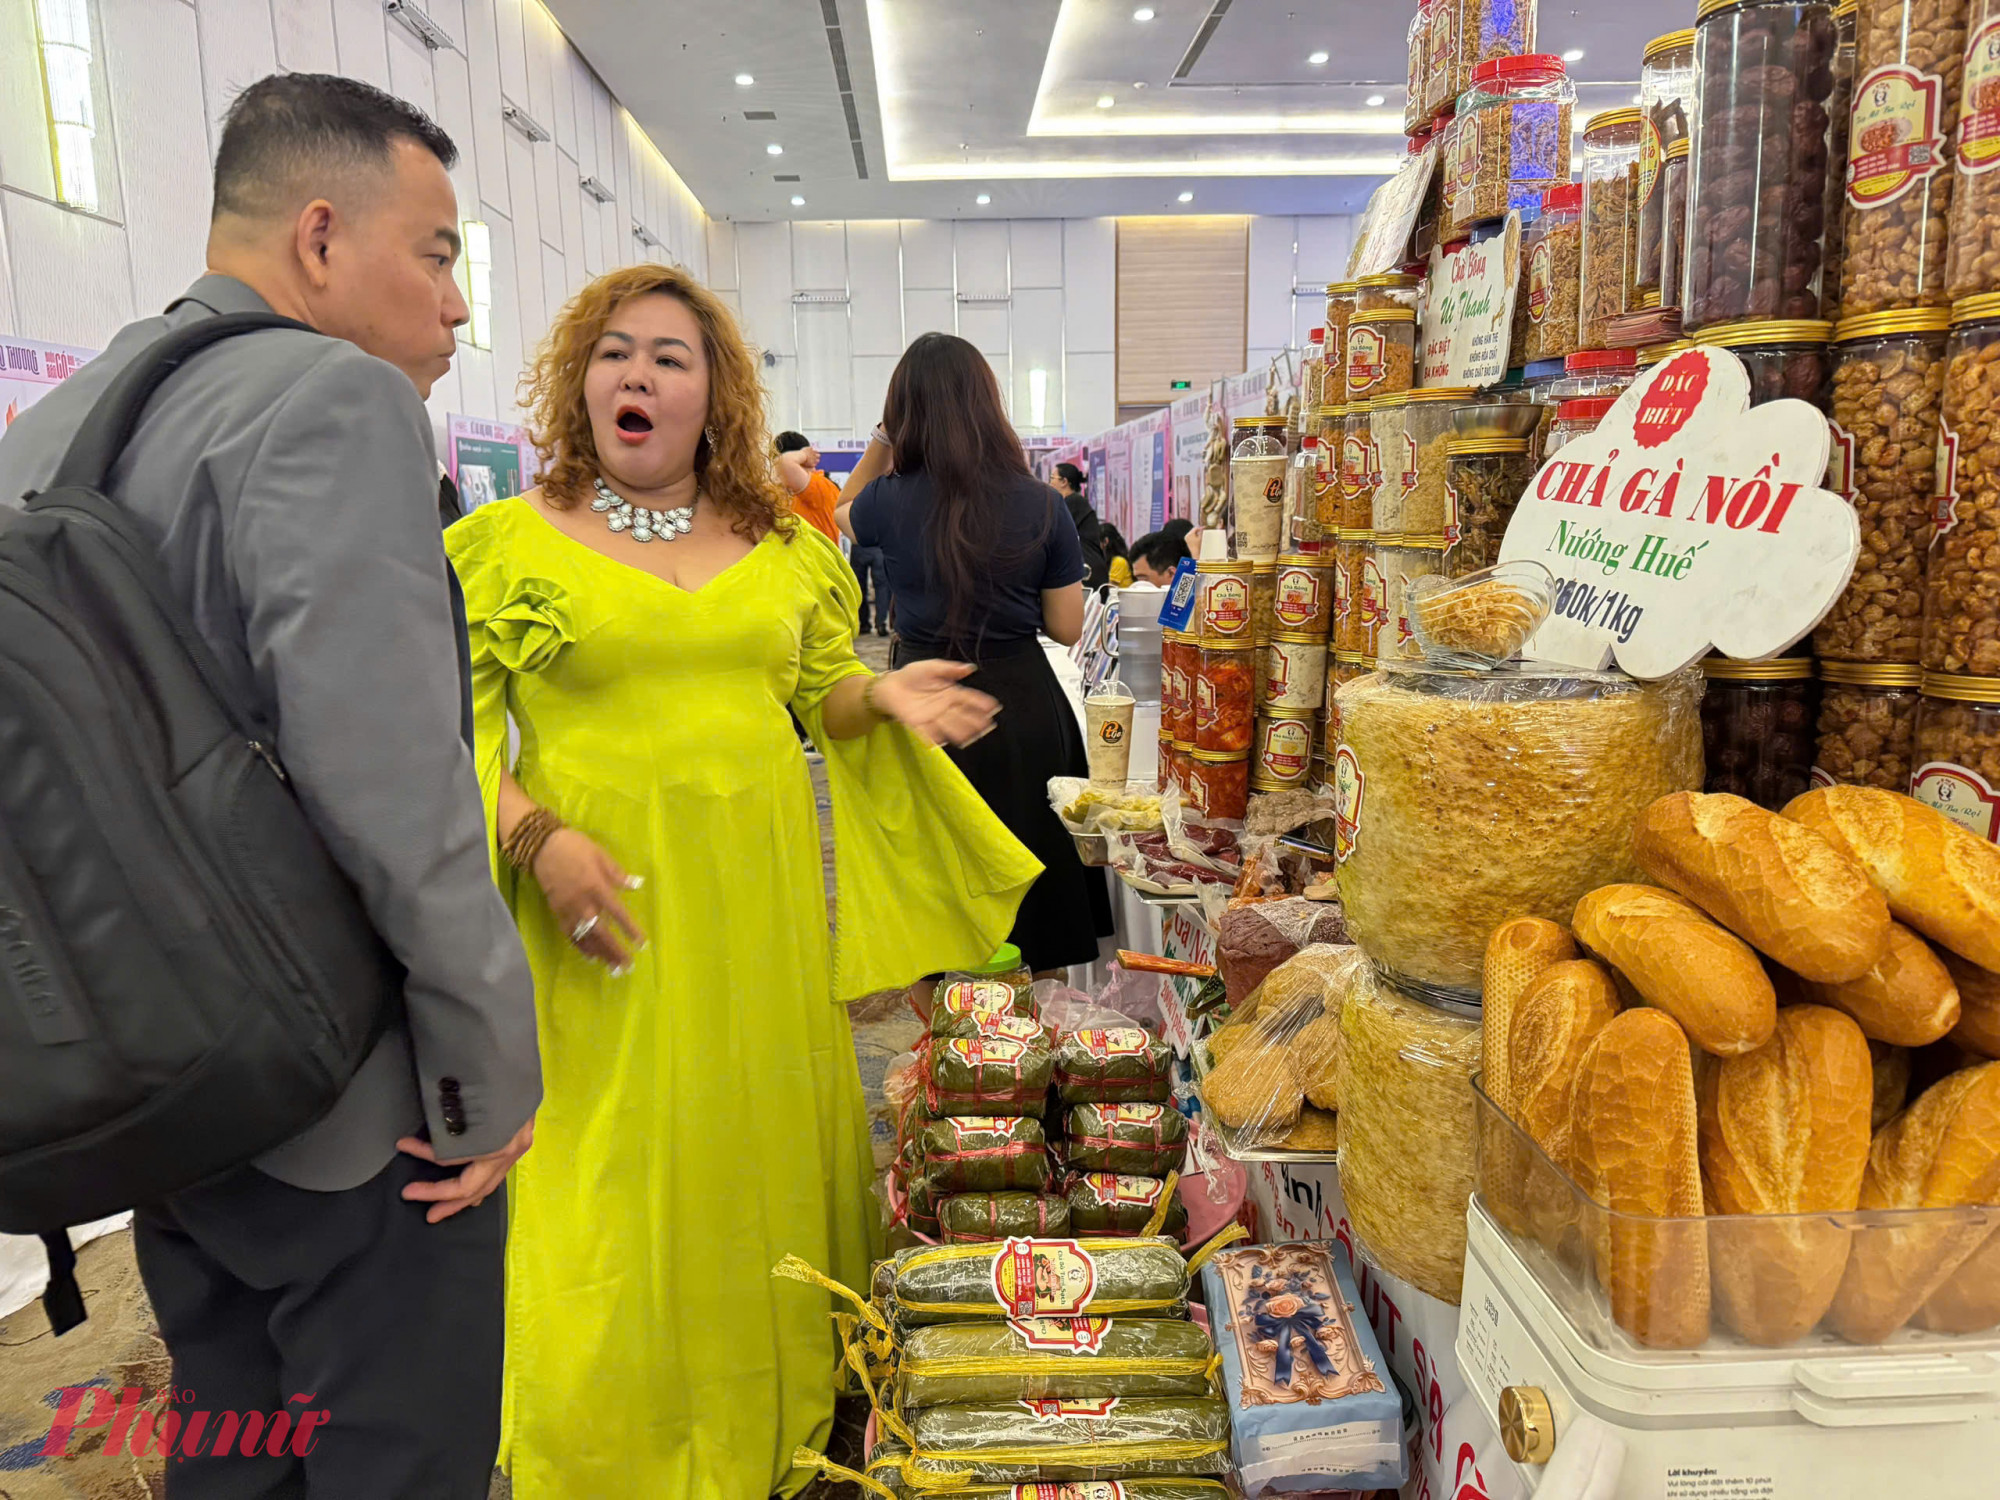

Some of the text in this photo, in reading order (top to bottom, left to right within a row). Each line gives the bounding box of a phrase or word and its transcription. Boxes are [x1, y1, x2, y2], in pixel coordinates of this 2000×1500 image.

[1459, 283, 1493, 321] Thanh
[1659, 369, 1701, 397] ĐẶC
[1640, 402, 1687, 430] BIỆT
[1536, 449, 1804, 534] CHẢ GÀ NỒI
[1546, 520, 1710, 581] Nướng Huế
